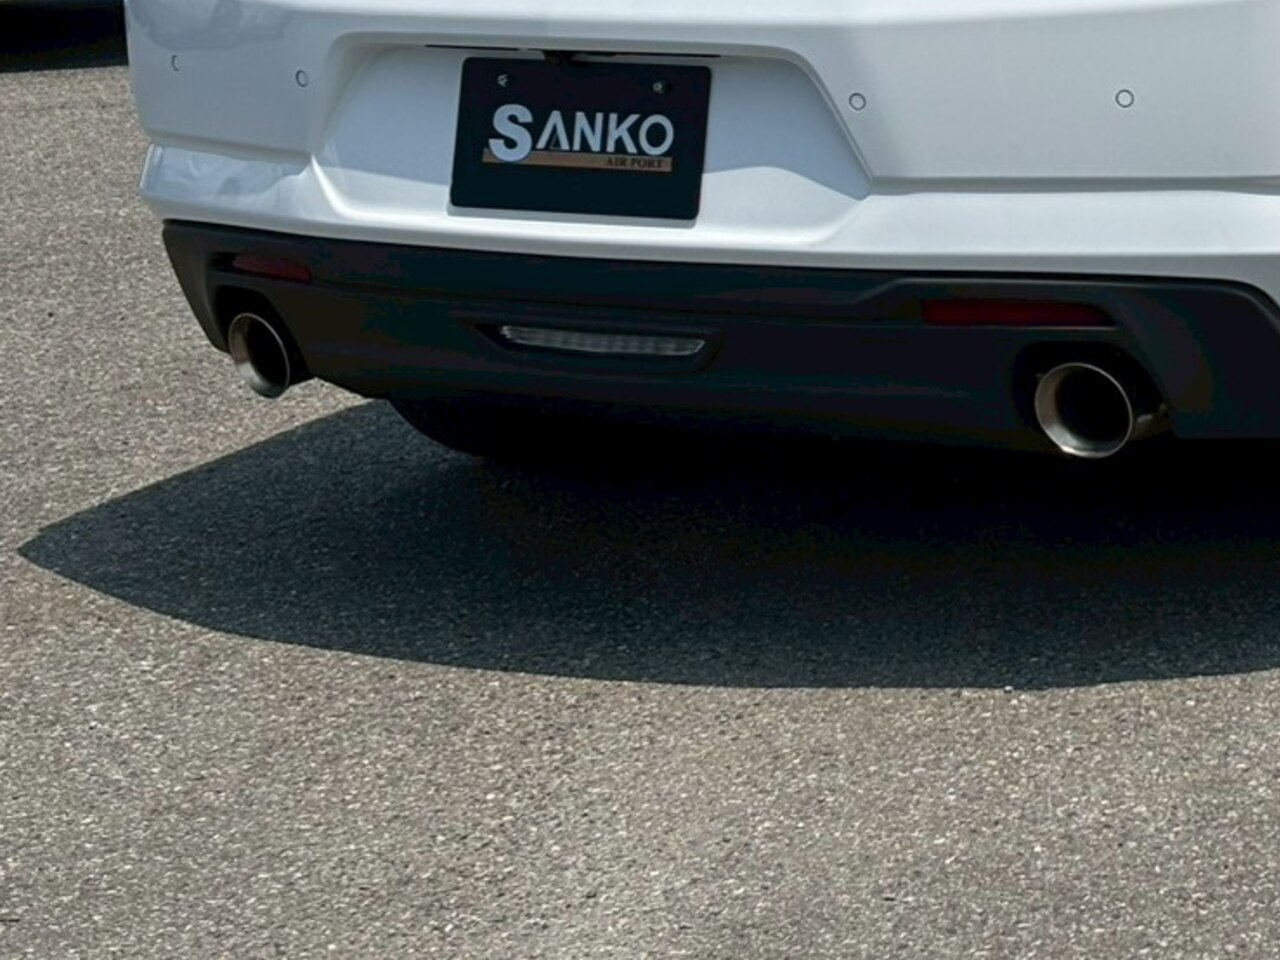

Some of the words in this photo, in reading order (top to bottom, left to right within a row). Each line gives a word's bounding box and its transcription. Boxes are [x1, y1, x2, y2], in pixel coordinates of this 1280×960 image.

[488, 103, 675, 163] SANKO
[606, 156, 627, 167] AIR
[630, 158, 663, 169] PORT
